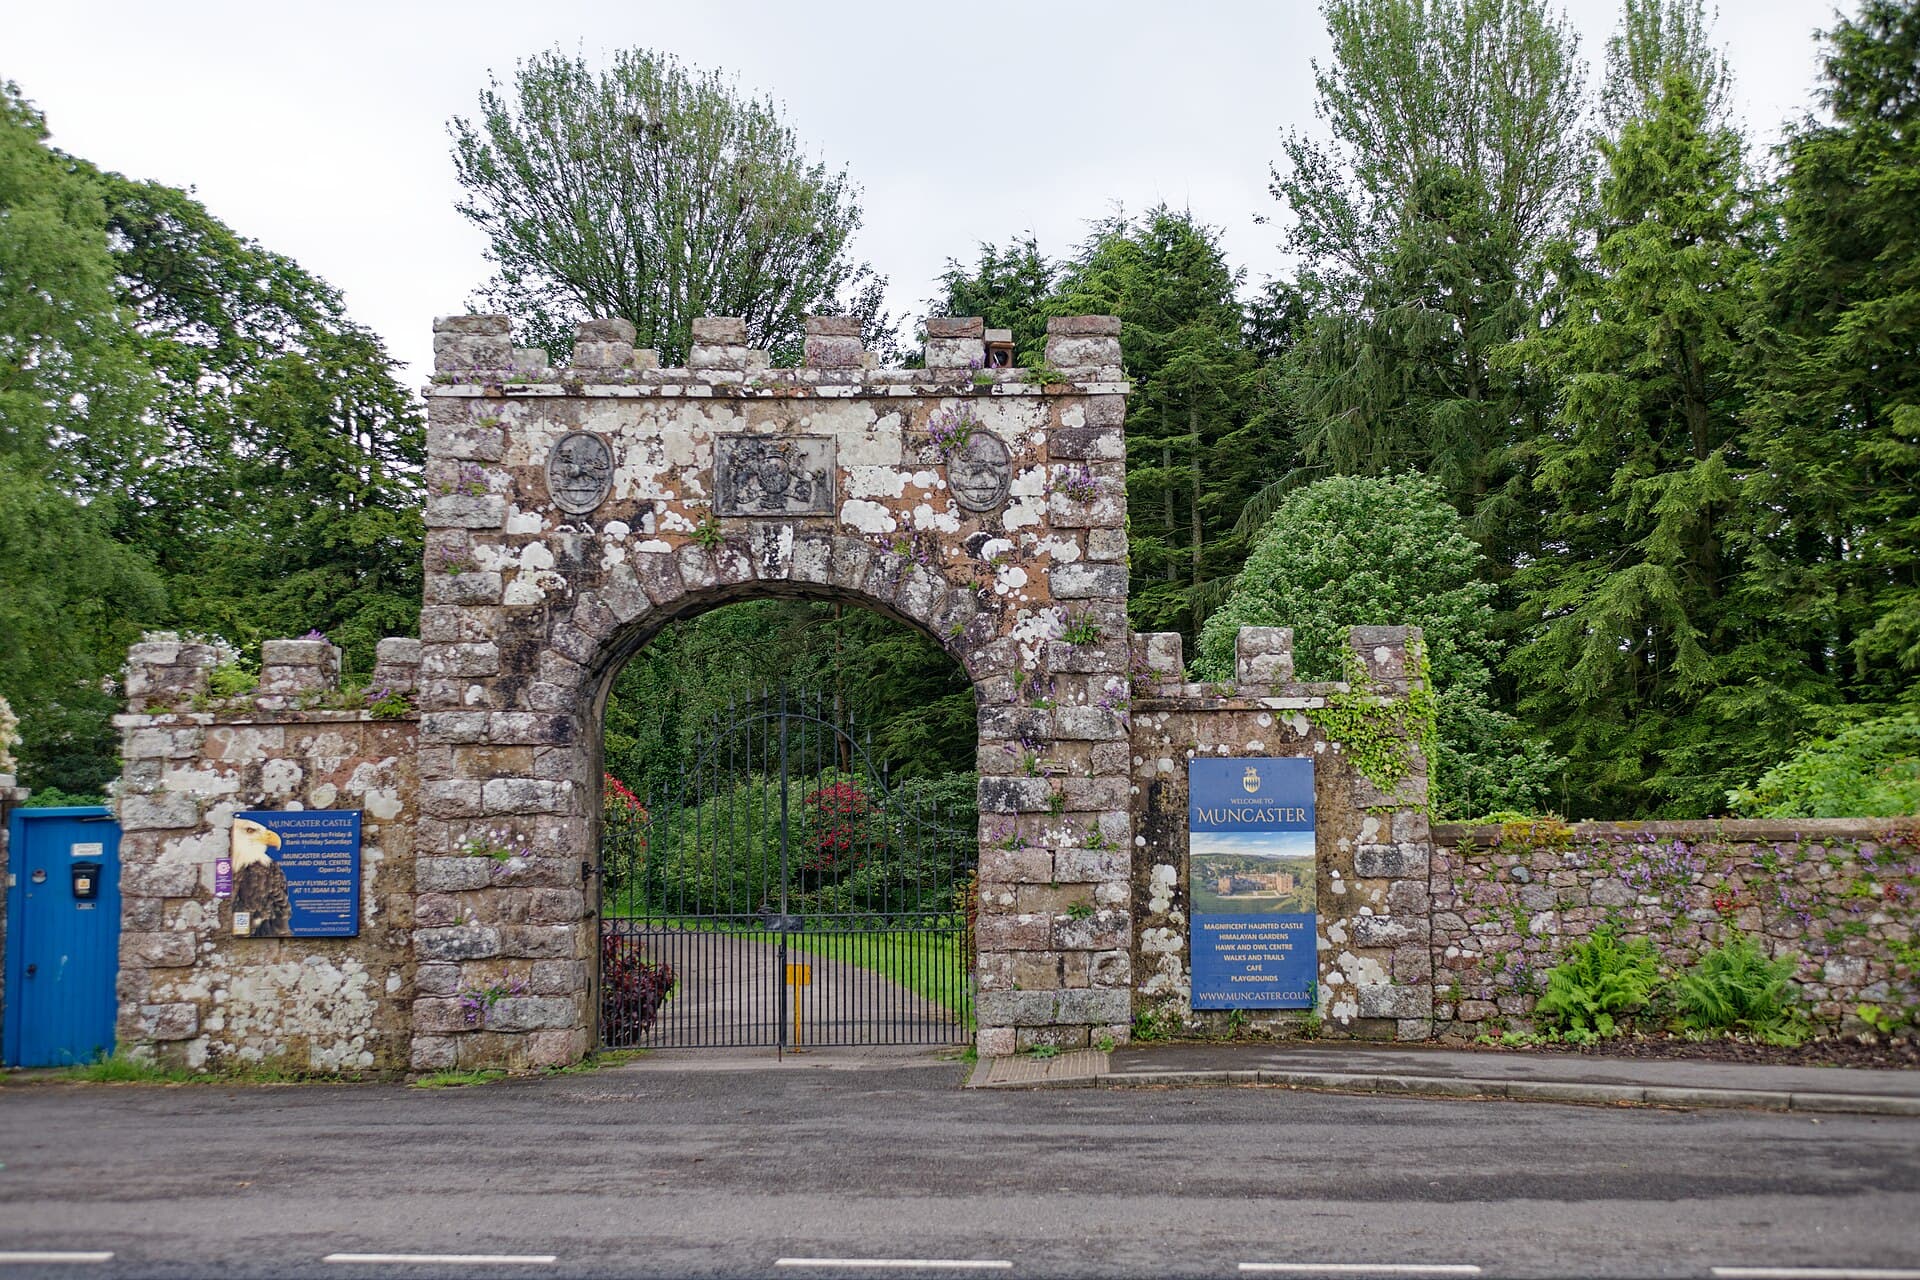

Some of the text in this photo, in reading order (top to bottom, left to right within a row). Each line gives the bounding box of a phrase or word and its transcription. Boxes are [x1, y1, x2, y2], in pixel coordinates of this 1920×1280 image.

[269, 819, 353, 828] MUNCASTER CASTLE
[1198, 807, 1307, 826] MUNCASTER
